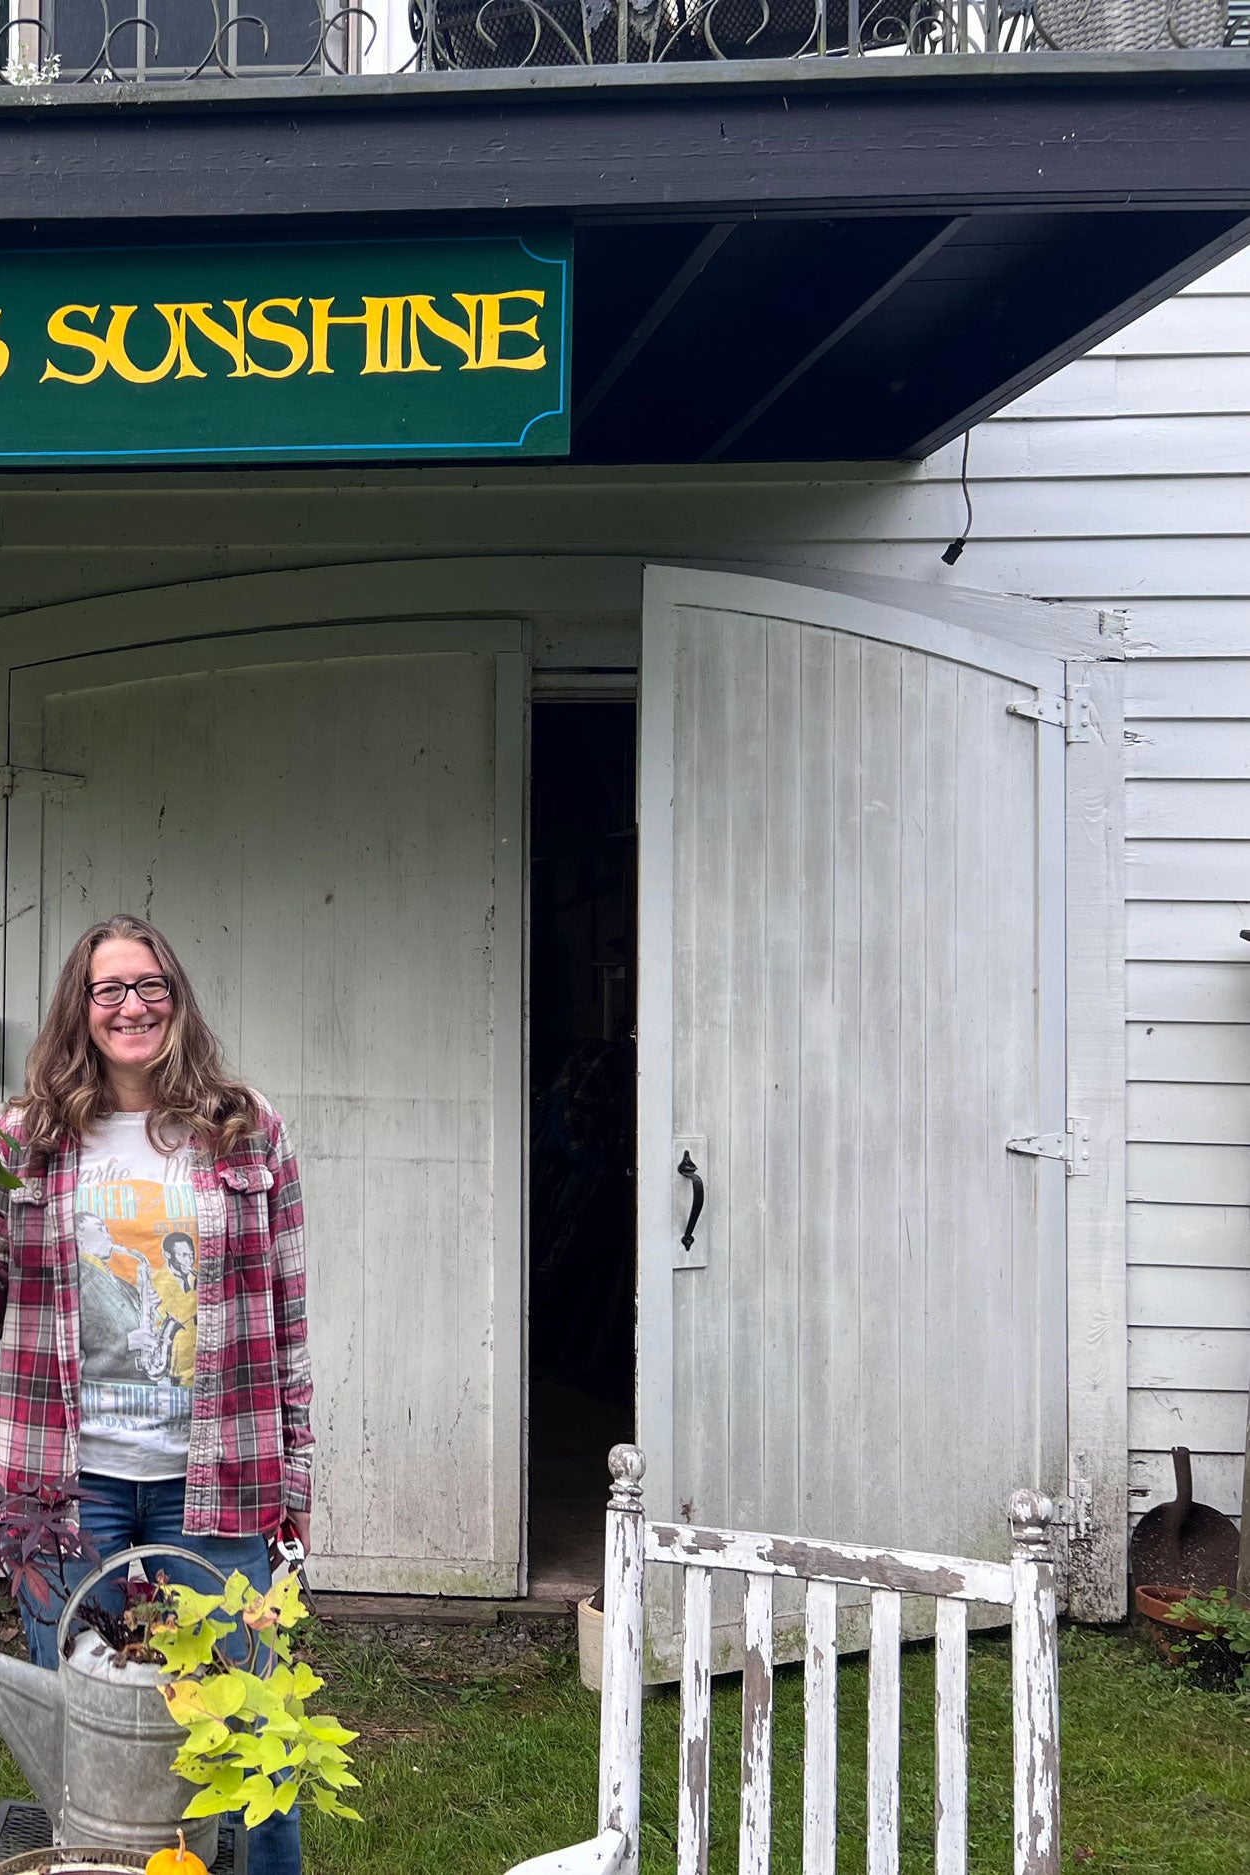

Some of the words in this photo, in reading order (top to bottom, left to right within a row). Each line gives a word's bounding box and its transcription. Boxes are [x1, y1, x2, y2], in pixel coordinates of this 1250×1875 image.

[39, 290, 547, 384] SUNSHINE
[81, 1381, 104, 1414] HE
[111, 1385, 163, 1420] THREE
